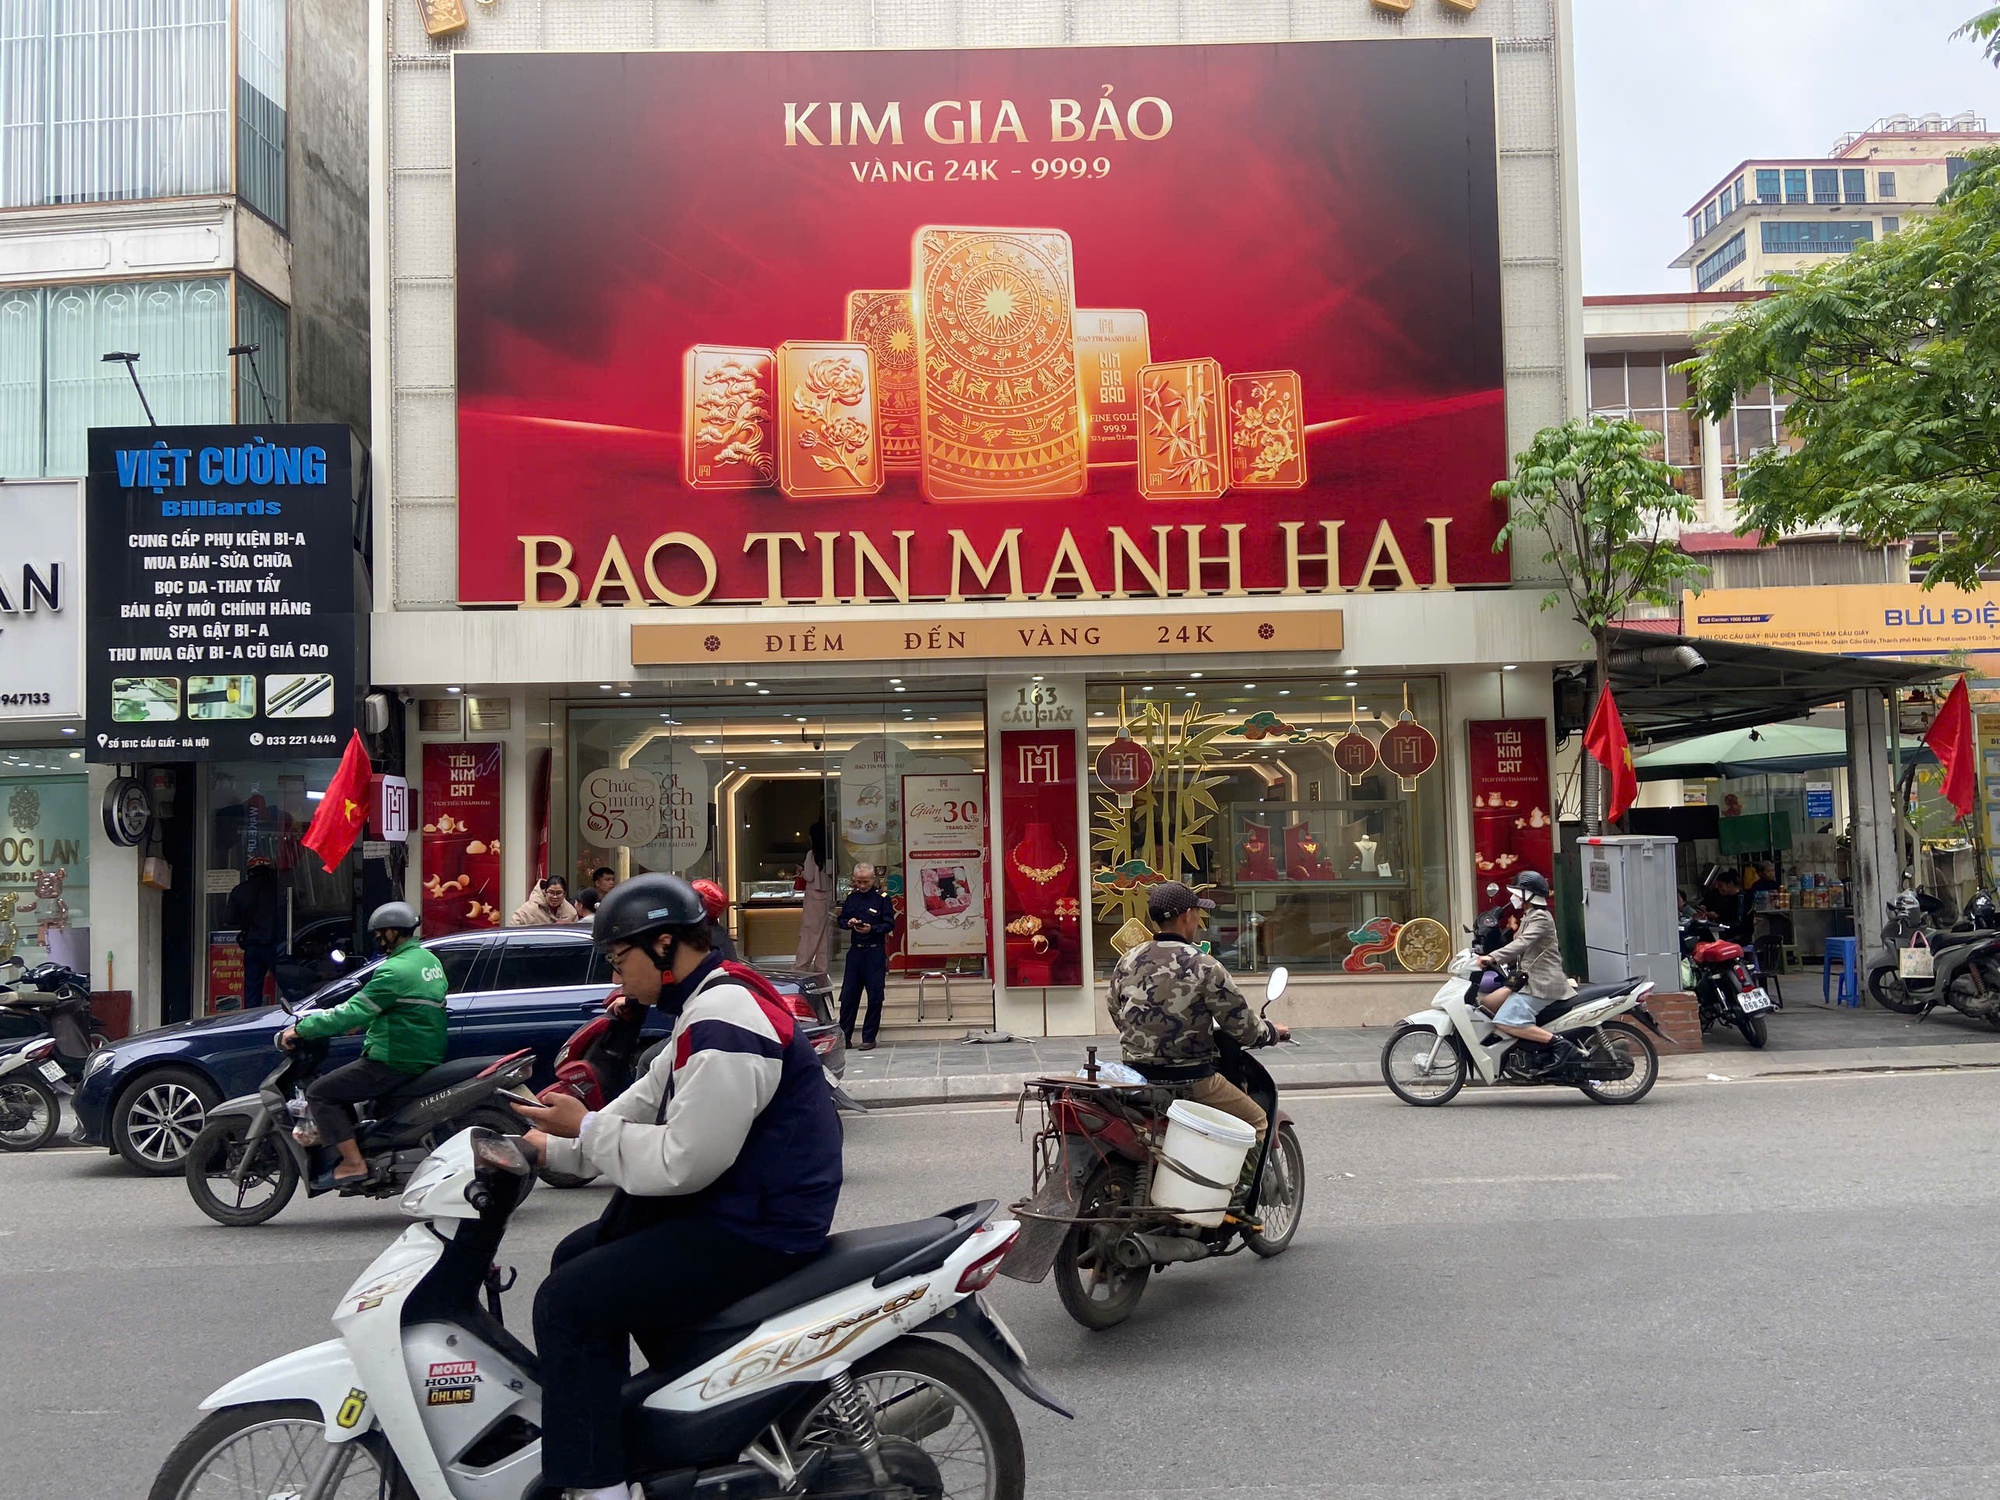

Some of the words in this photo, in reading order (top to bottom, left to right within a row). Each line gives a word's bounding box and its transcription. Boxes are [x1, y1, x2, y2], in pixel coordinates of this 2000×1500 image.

[783, 101, 905, 147] KIM
[924, 99, 1029, 145] GIA
[1050, 84, 1173, 143] BẢO
[850, 157, 934, 183] VÀNG
[944, 159, 999, 182] 24K
[1031, 156, 1111, 179] 999.9
[1090, 414, 1111, 422] FINE
[1103, 425, 1127, 433] 999.9
[116, 440, 192, 494] VIỆT
[199, 436, 327, 485] CƯỜNG
[162, 500, 282, 517] Billiards
[128, 534, 168, 547] CUNG
[172, 528, 200, 547] CẤP
[204, 533, 233, 549] PHỤ
[236, 530, 271, 548] KIỆN
[274, 532, 306, 546] BI-A
[144, 556, 177, 570] MUA
[180, 553, 210, 569] BÁN
[220, 550, 250, 568] SỬA
[253, 552, 292, 568] CHỮA
[517, 530, 717, 610] BAO
[743, 530, 915, 605] TIN
[947, 523, 1247, 603] MANH
[1279, 517, 1454, 596] HAI
[155, 581, 183, 597] BỌC
[188, 581, 208, 594] DA
[256, 573, 281, 593] TẨY
[121, 602, 150, 618] BÁN
[155, 601, 182, 620] GẬY
[187, 599, 215, 616] MỚI
[221, 600, 266, 616] CHÍNH
[270, 599, 312, 615] HÃNG
[1885, 605, 1945, 626] BƯU
[169, 624, 198, 638] SPA
[203, 622, 230, 640] GẬY
[765, 626, 845, 653] ĐIỂM
[904, 625, 966, 651] ĐẾN
[1018, 624, 1101, 648] VÀNG
[1157, 624, 1215, 645] 24K
[109, 648, 136, 662] THU
[140, 647, 172, 661] MUA
[176, 643, 204, 663] GẬY
[247, 642, 267, 659] CŨ
[270, 642, 295, 658] GIÁ
[300, 643, 329, 658] CAO
[1017, 687, 1057, 706] 163
[108, 738, 119, 749] SỐ
[121, 739, 138, 748] 161C
[182, 737, 193, 747] HÀ
[195, 737, 209, 748] NỘI
[266, 736, 286, 746] 033
[289, 735, 307, 745] 221
[310, 735, 337, 744] 4444
[590, 777, 637, 799] Chúc
[609, 793, 655, 810] mừng
[39, 838, 80, 866] LAN
[421, 964, 443, 982] Grab
[420, 1089, 452, 1108] SIRIUS
[431, 1363, 474, 1376] MOTUL
[424, 1375, 485, 1387] HONDA
